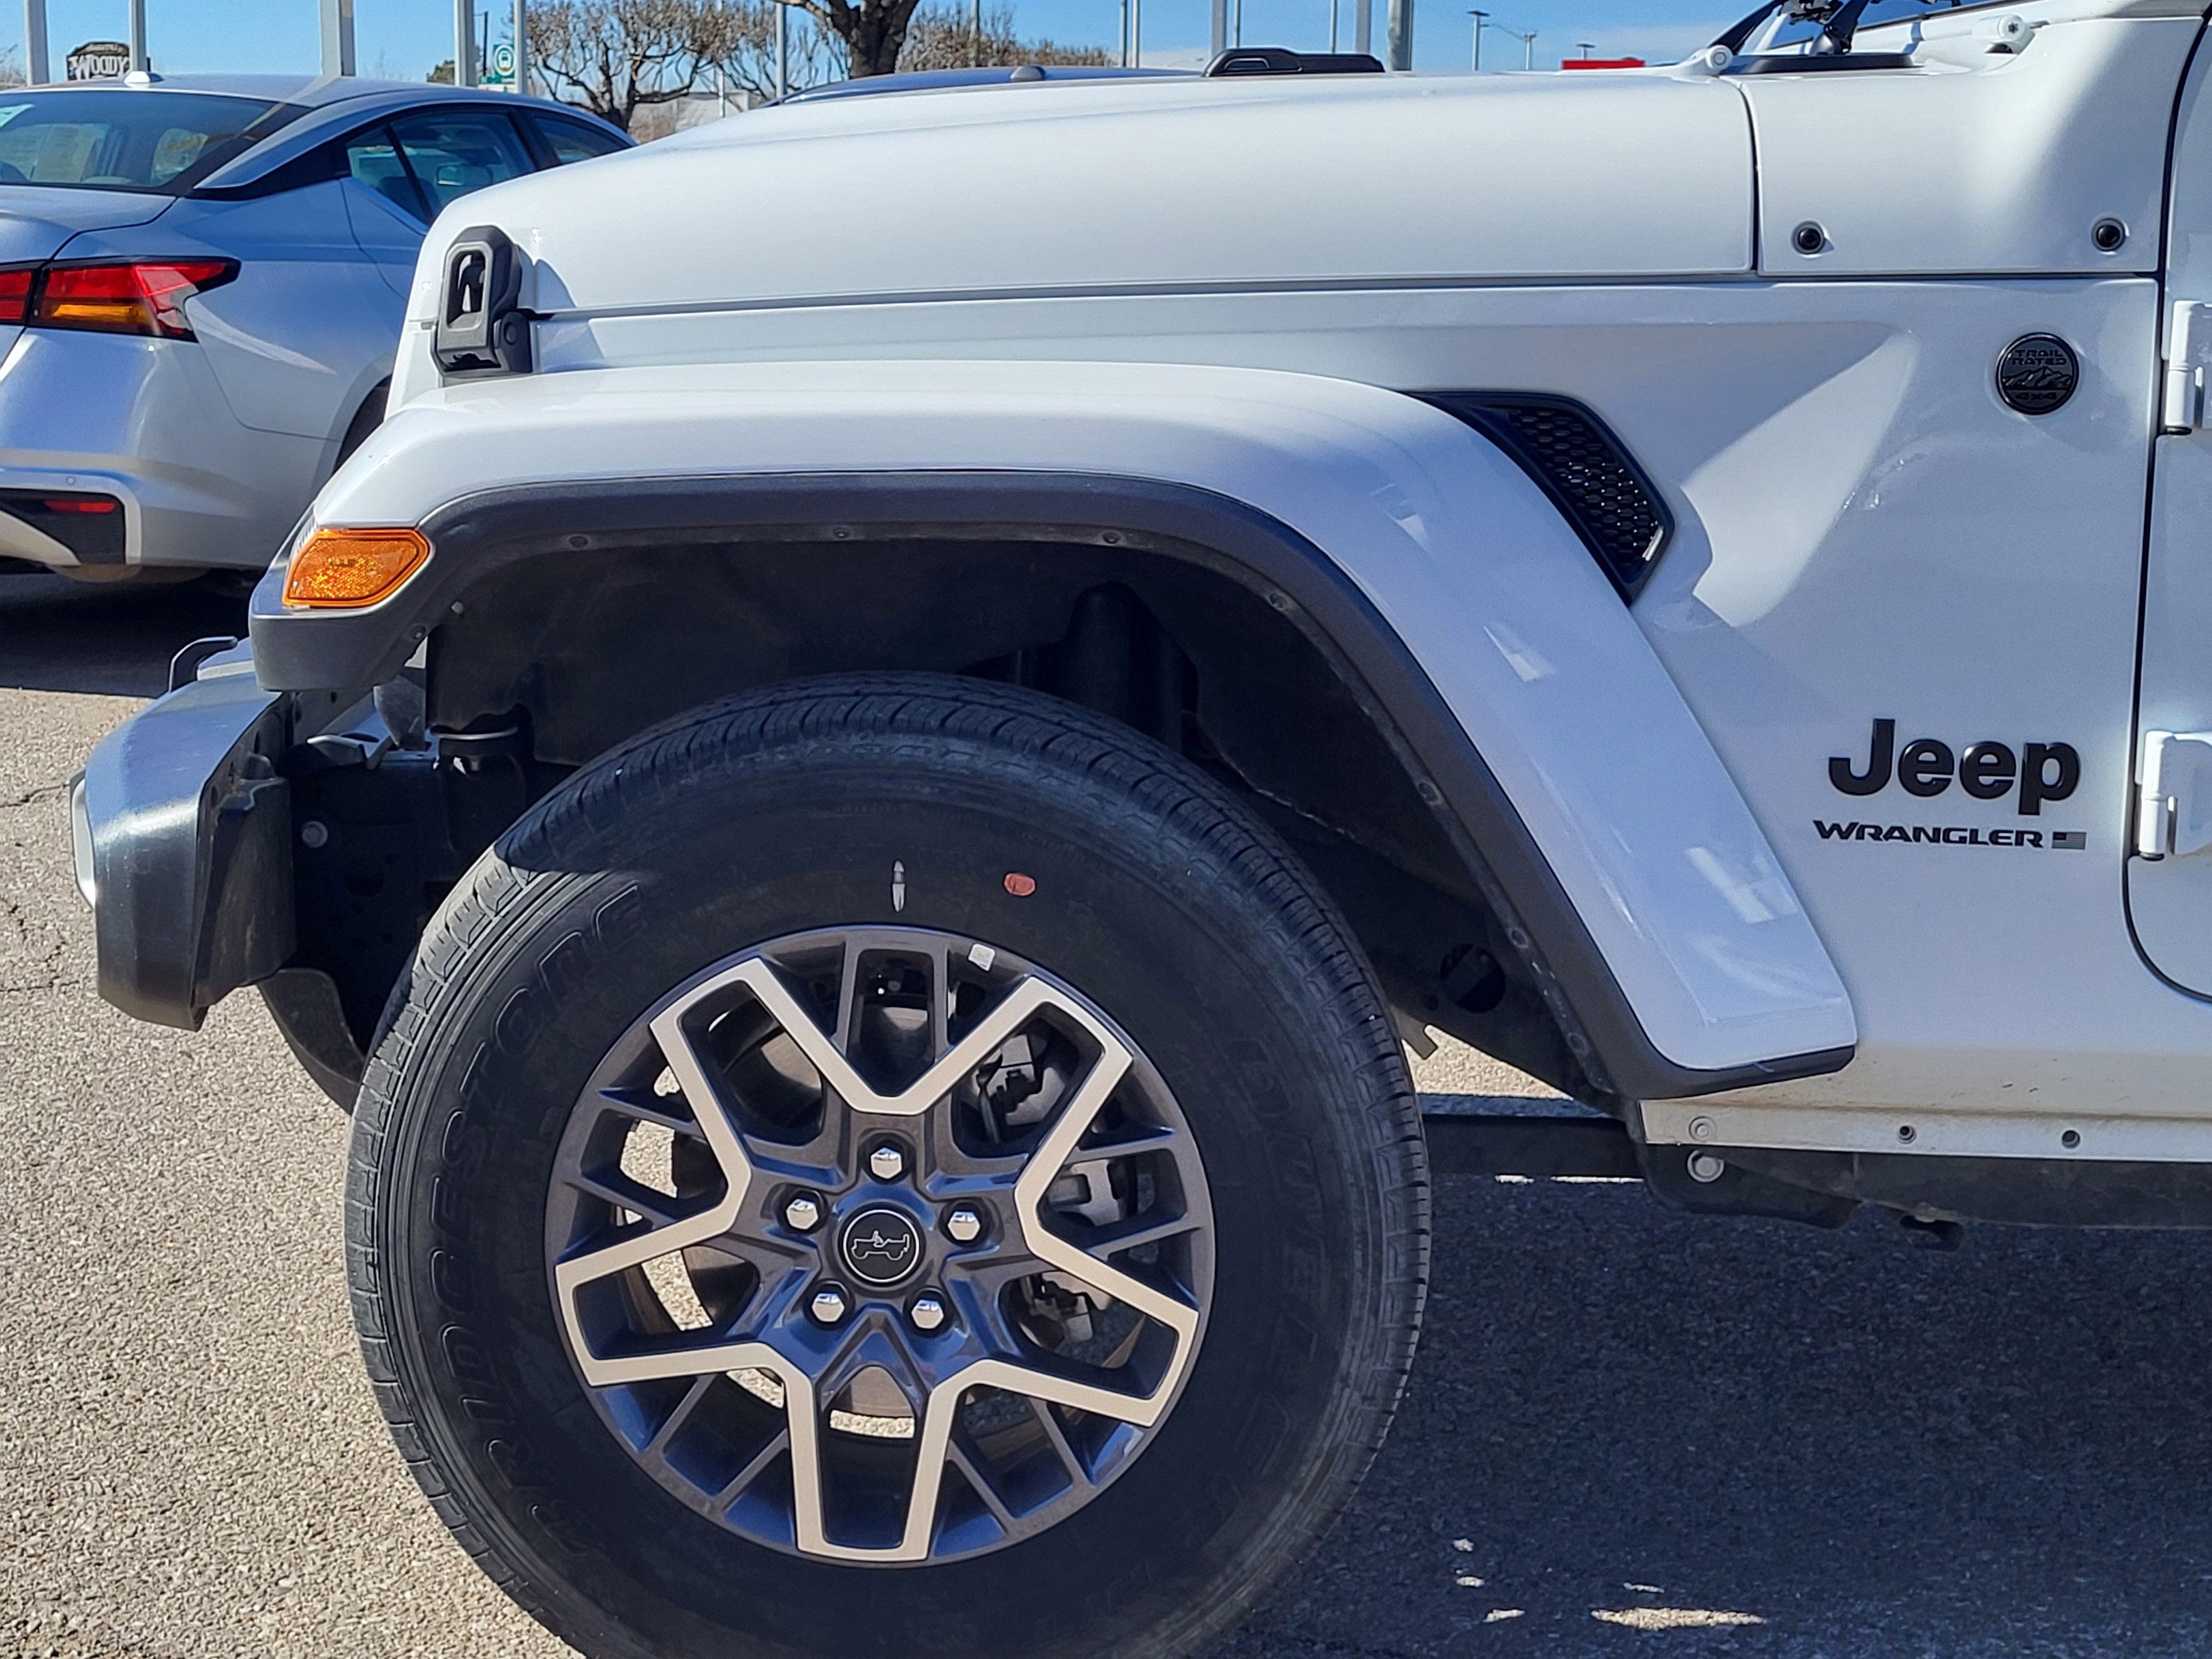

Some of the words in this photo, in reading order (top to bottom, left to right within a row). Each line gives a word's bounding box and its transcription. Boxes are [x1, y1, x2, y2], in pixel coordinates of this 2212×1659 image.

[2012, 357, 2067, 366] RATED
[1828, 718, 2080, 816] Jeep
[1813, 820, 2044, 848] WRANGLER
